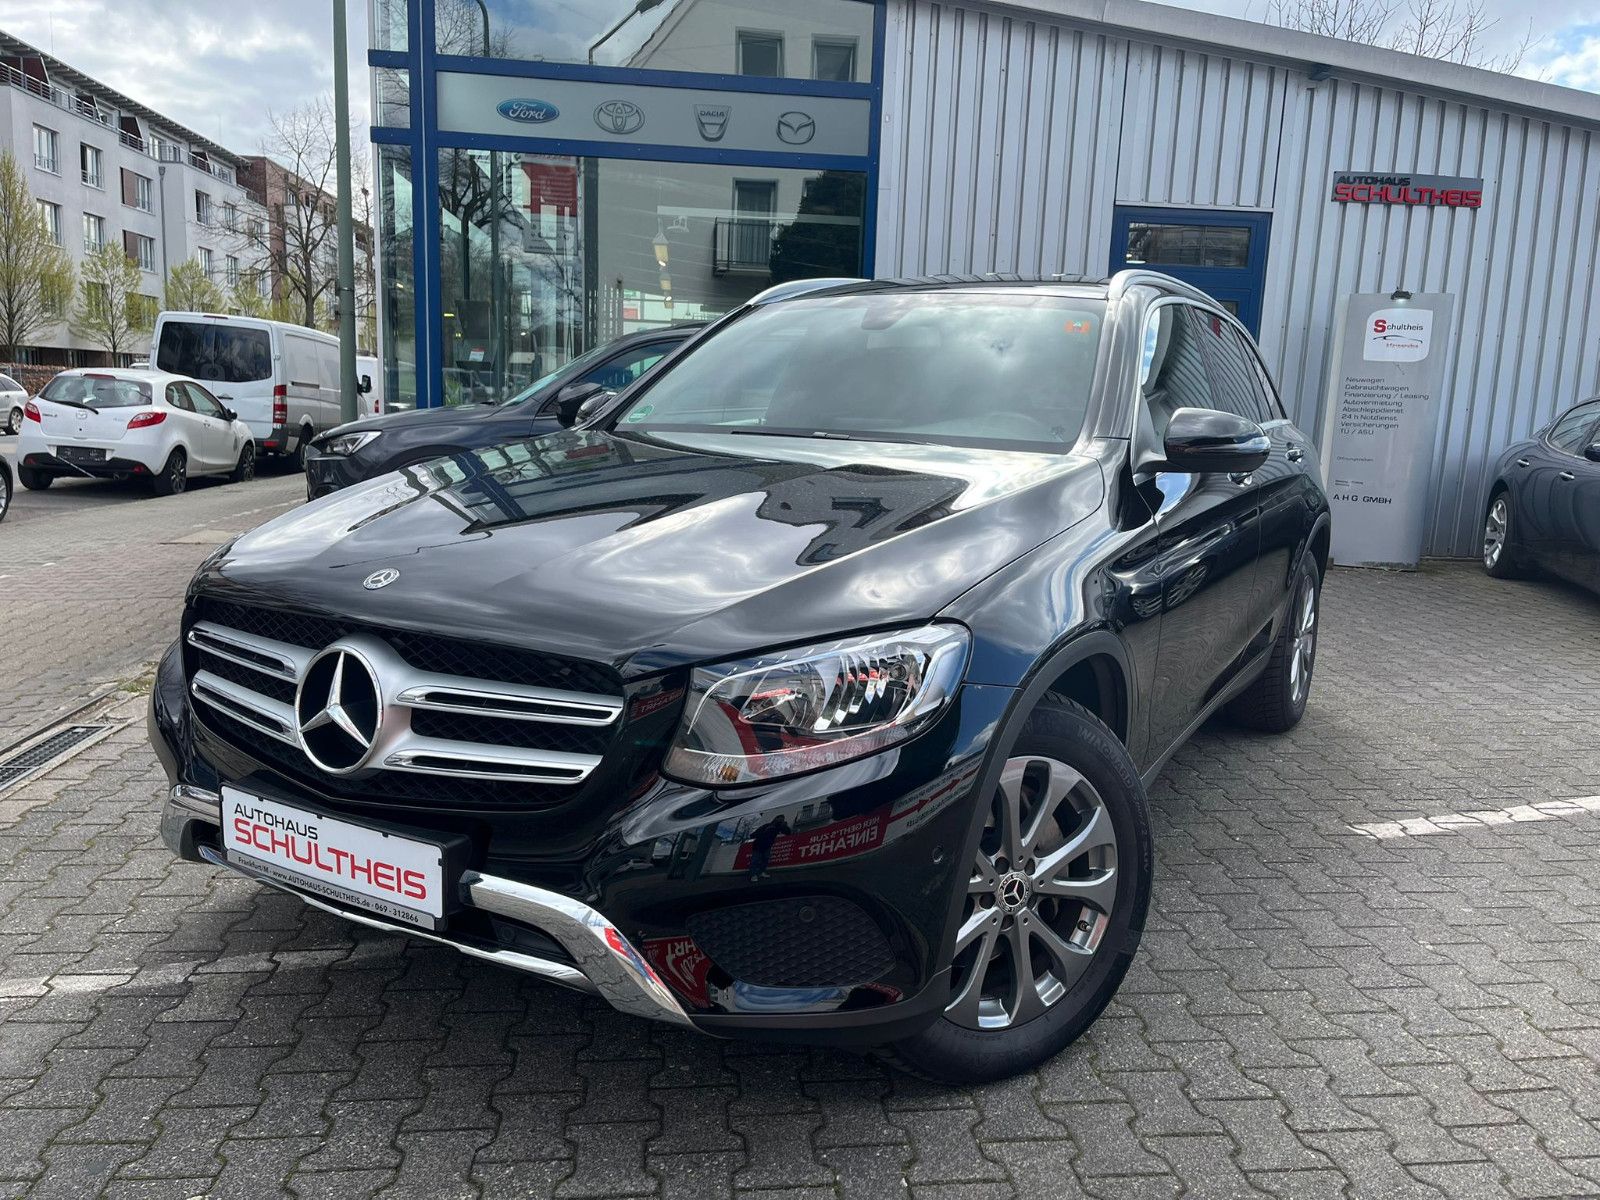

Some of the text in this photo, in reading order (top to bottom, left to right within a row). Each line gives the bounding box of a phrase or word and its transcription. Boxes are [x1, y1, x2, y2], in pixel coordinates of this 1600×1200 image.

[509, 102, 547, 119] Ford
[1337, 176, 1411, 186] AUTOHAUS
[1335, 184, 1482, 207] SCHULTHEIS
[1374, 319, 1423, 333] Schultheis
[1346, 376, 1385, 384] Neuwagen
[1345, 384, 1409, 392] Gebrauchtwagen
[1344, 391, 1391, 399] Finanzierung
[1343, 399, 1403, 407] Autovermietung
[1342, 406, 1404, 414] Abschleppdienst
[1341, 421, 1399, 429] Versicherungen
[1362, 495, 1392, 504] GMBH
[234, 802, 319, 841] AUTOHAUS
[234, 818, 427, 900] SCHULTHEIS
[374, 903, 388, 913] 069
[392, 908, 419, 923] 312866
